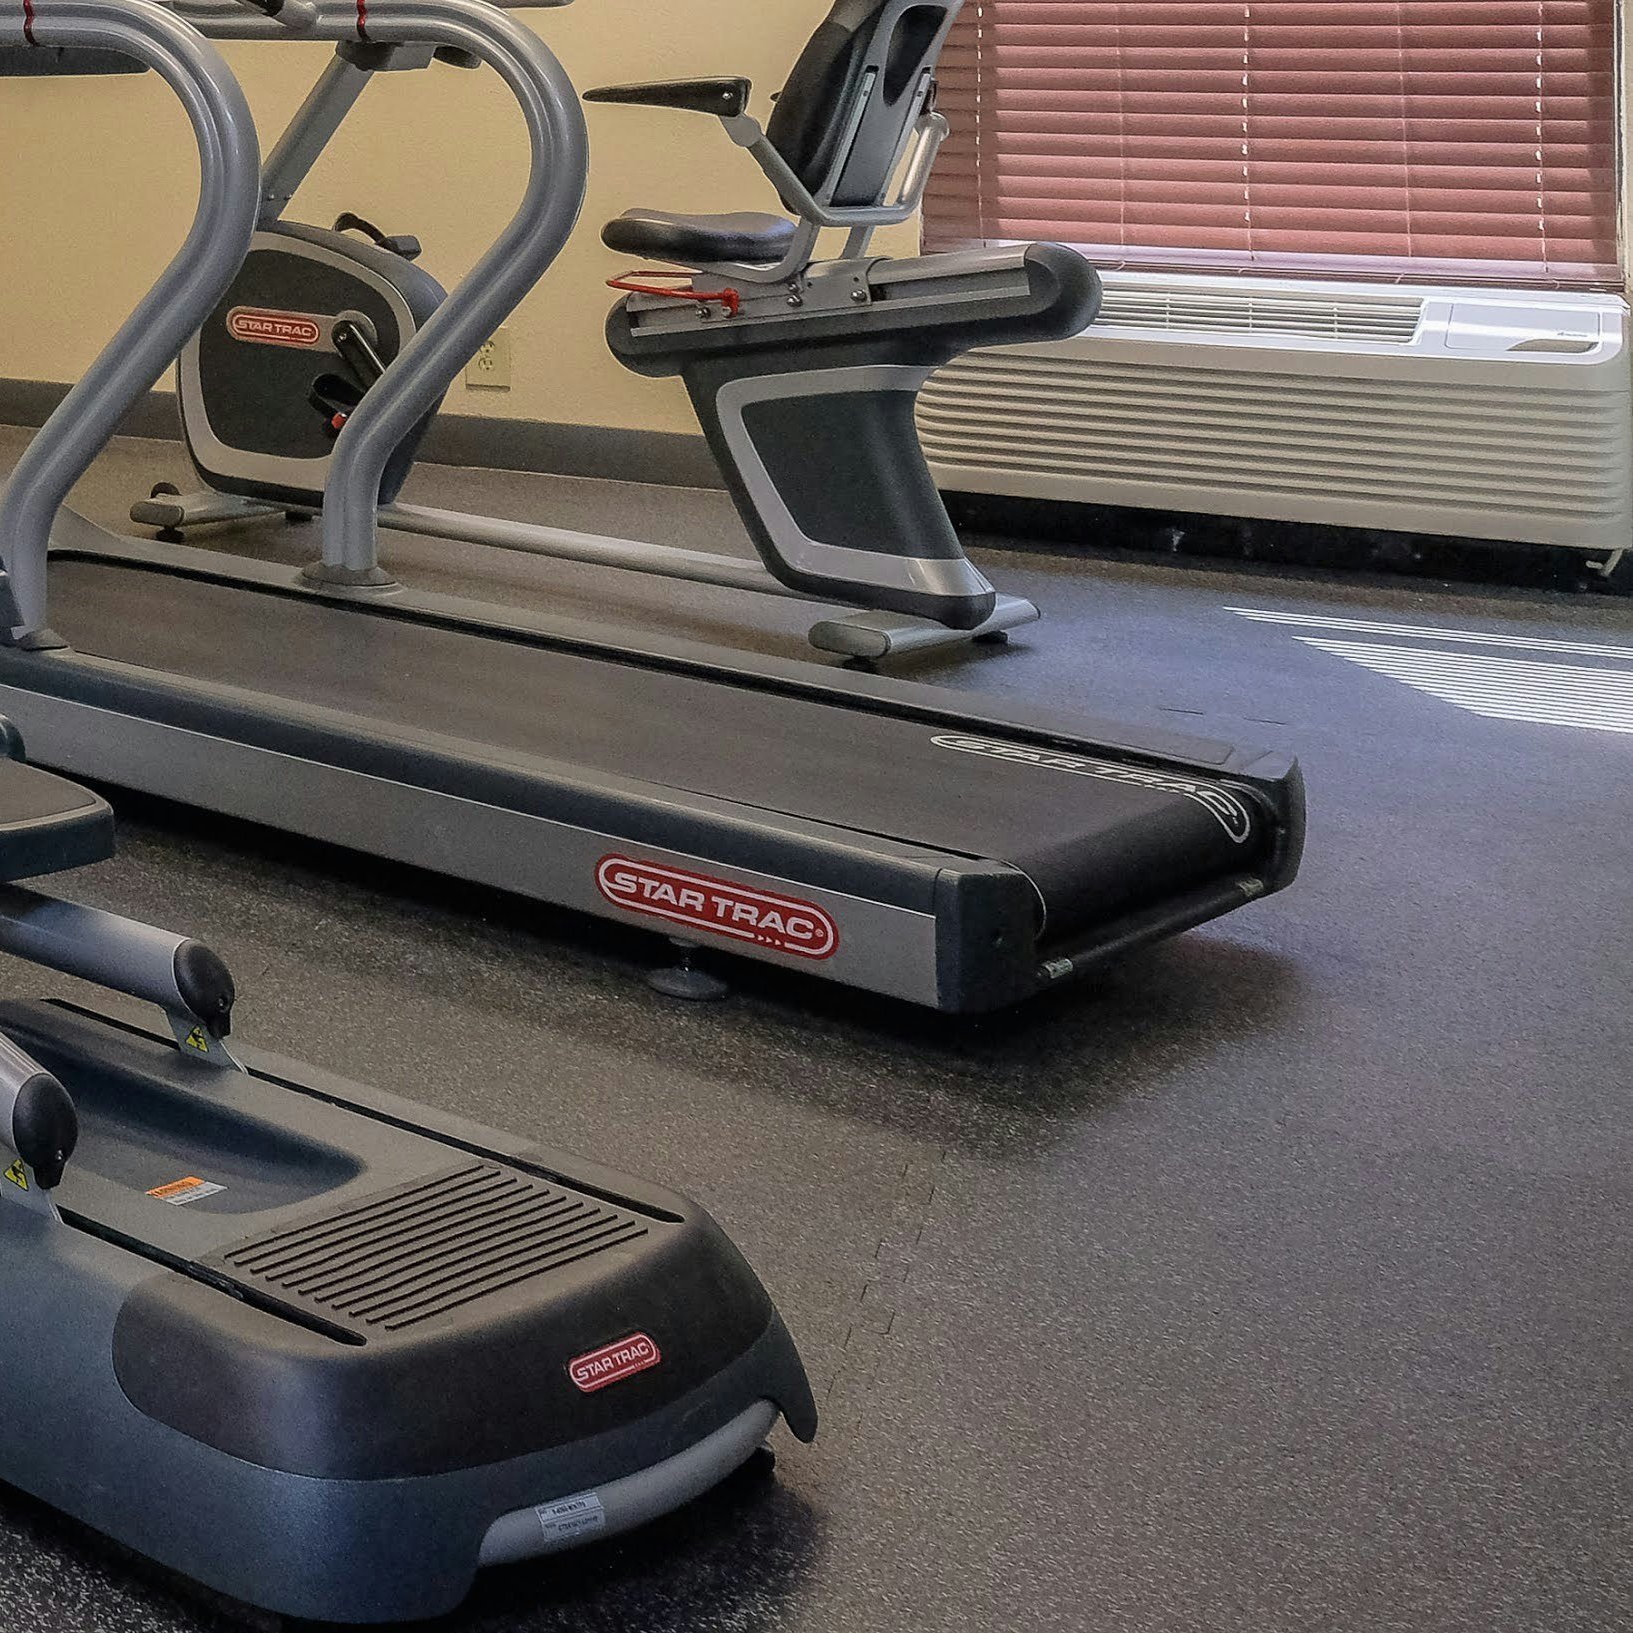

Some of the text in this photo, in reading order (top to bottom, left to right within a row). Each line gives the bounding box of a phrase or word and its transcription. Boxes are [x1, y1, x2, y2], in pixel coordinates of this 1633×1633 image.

[237, 319, 312, 337] STAR TRAC
[956, 739, 1238, 818] STAR TRAC
[609, 871, 815, 940] STAR TRAC
[577, 1342, 649, 1381] STAR TRAC
